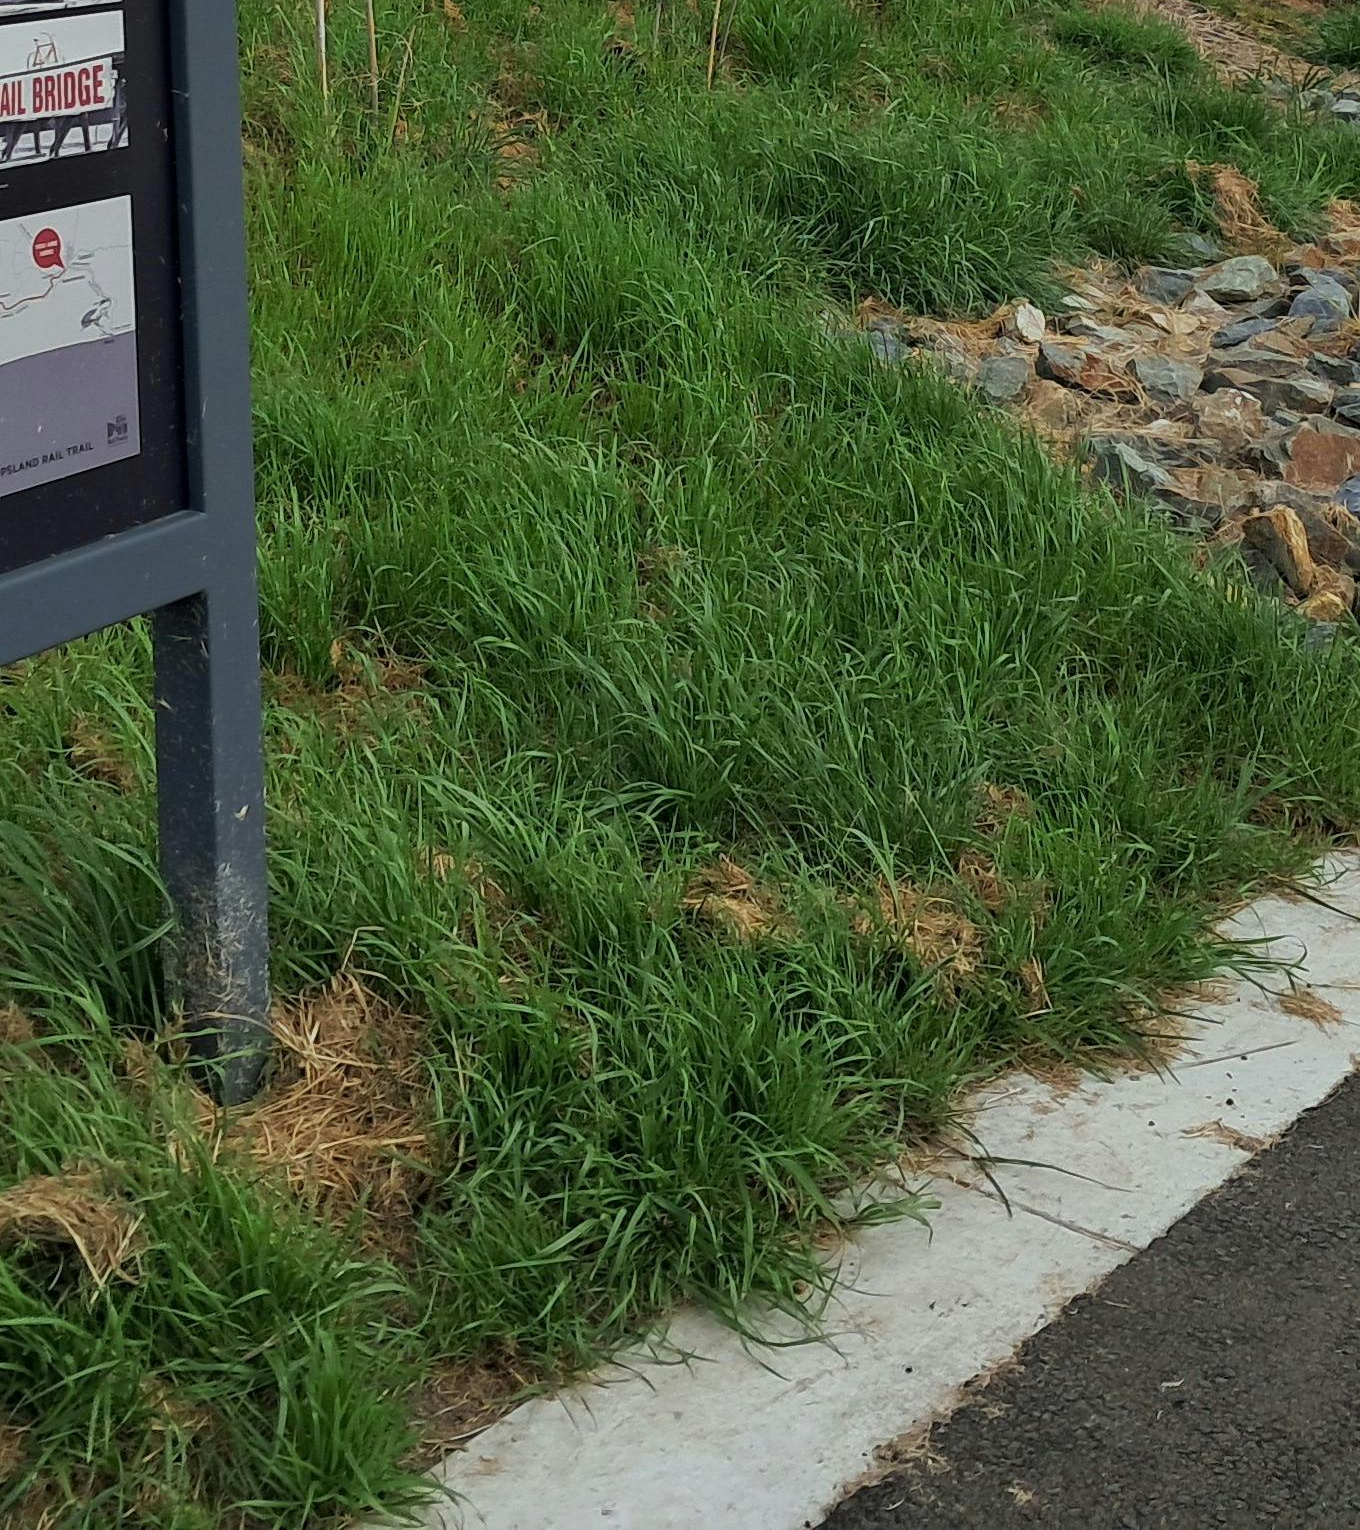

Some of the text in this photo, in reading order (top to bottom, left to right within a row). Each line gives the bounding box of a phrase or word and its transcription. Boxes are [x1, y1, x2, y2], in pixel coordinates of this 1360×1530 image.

[32, 65, 104, 113] BRIDGE
[42, 452, 63, 464] RAIL
[66, 443, 93, 455] TRAIL
